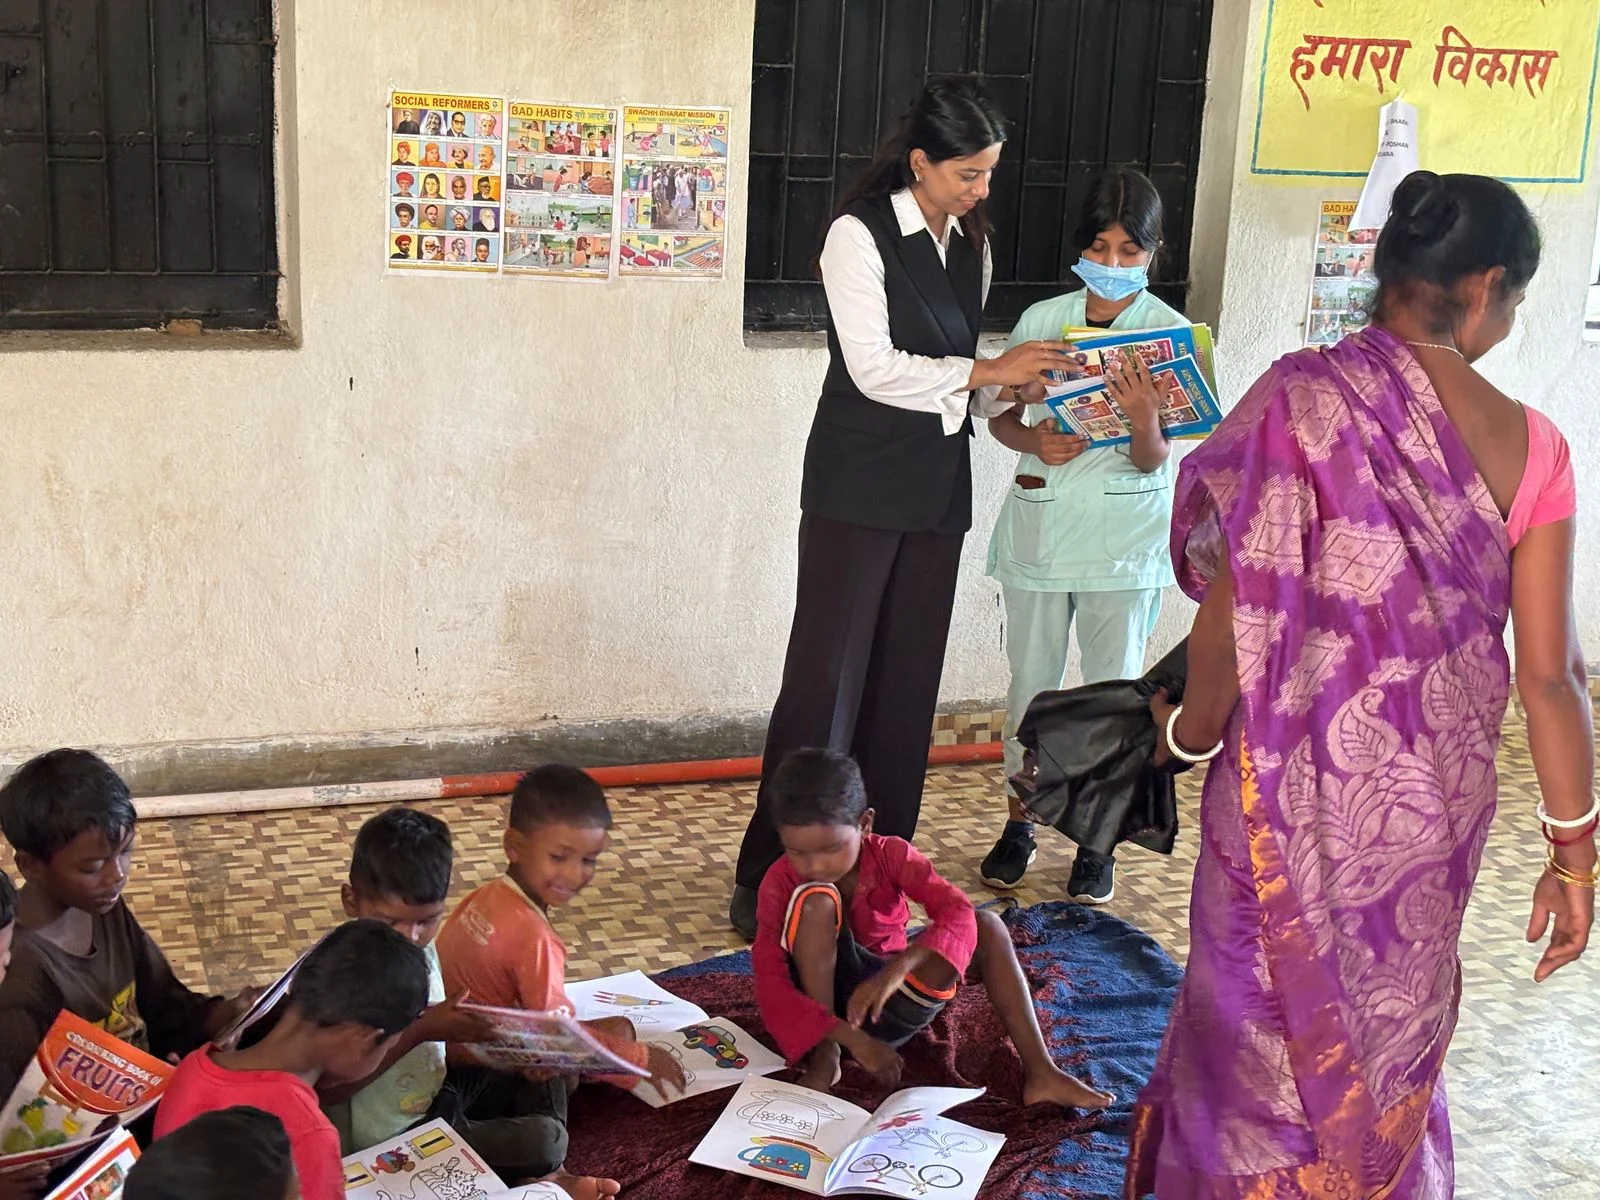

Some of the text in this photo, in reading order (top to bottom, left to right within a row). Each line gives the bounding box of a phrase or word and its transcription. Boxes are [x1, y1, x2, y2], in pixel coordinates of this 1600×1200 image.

[1289, 25, 1560, 112] हमारा विकास
[394, 95, 490, 110] SOCIAL REFORMERS
[511, 105, 573, 119] BAD HABITS
[628, 108, 716, 119] SWACHH BHARAT MISSION
[1323, 203, 1341, 213] BAD
[56, 1045, 146, 1107] FRUITS
